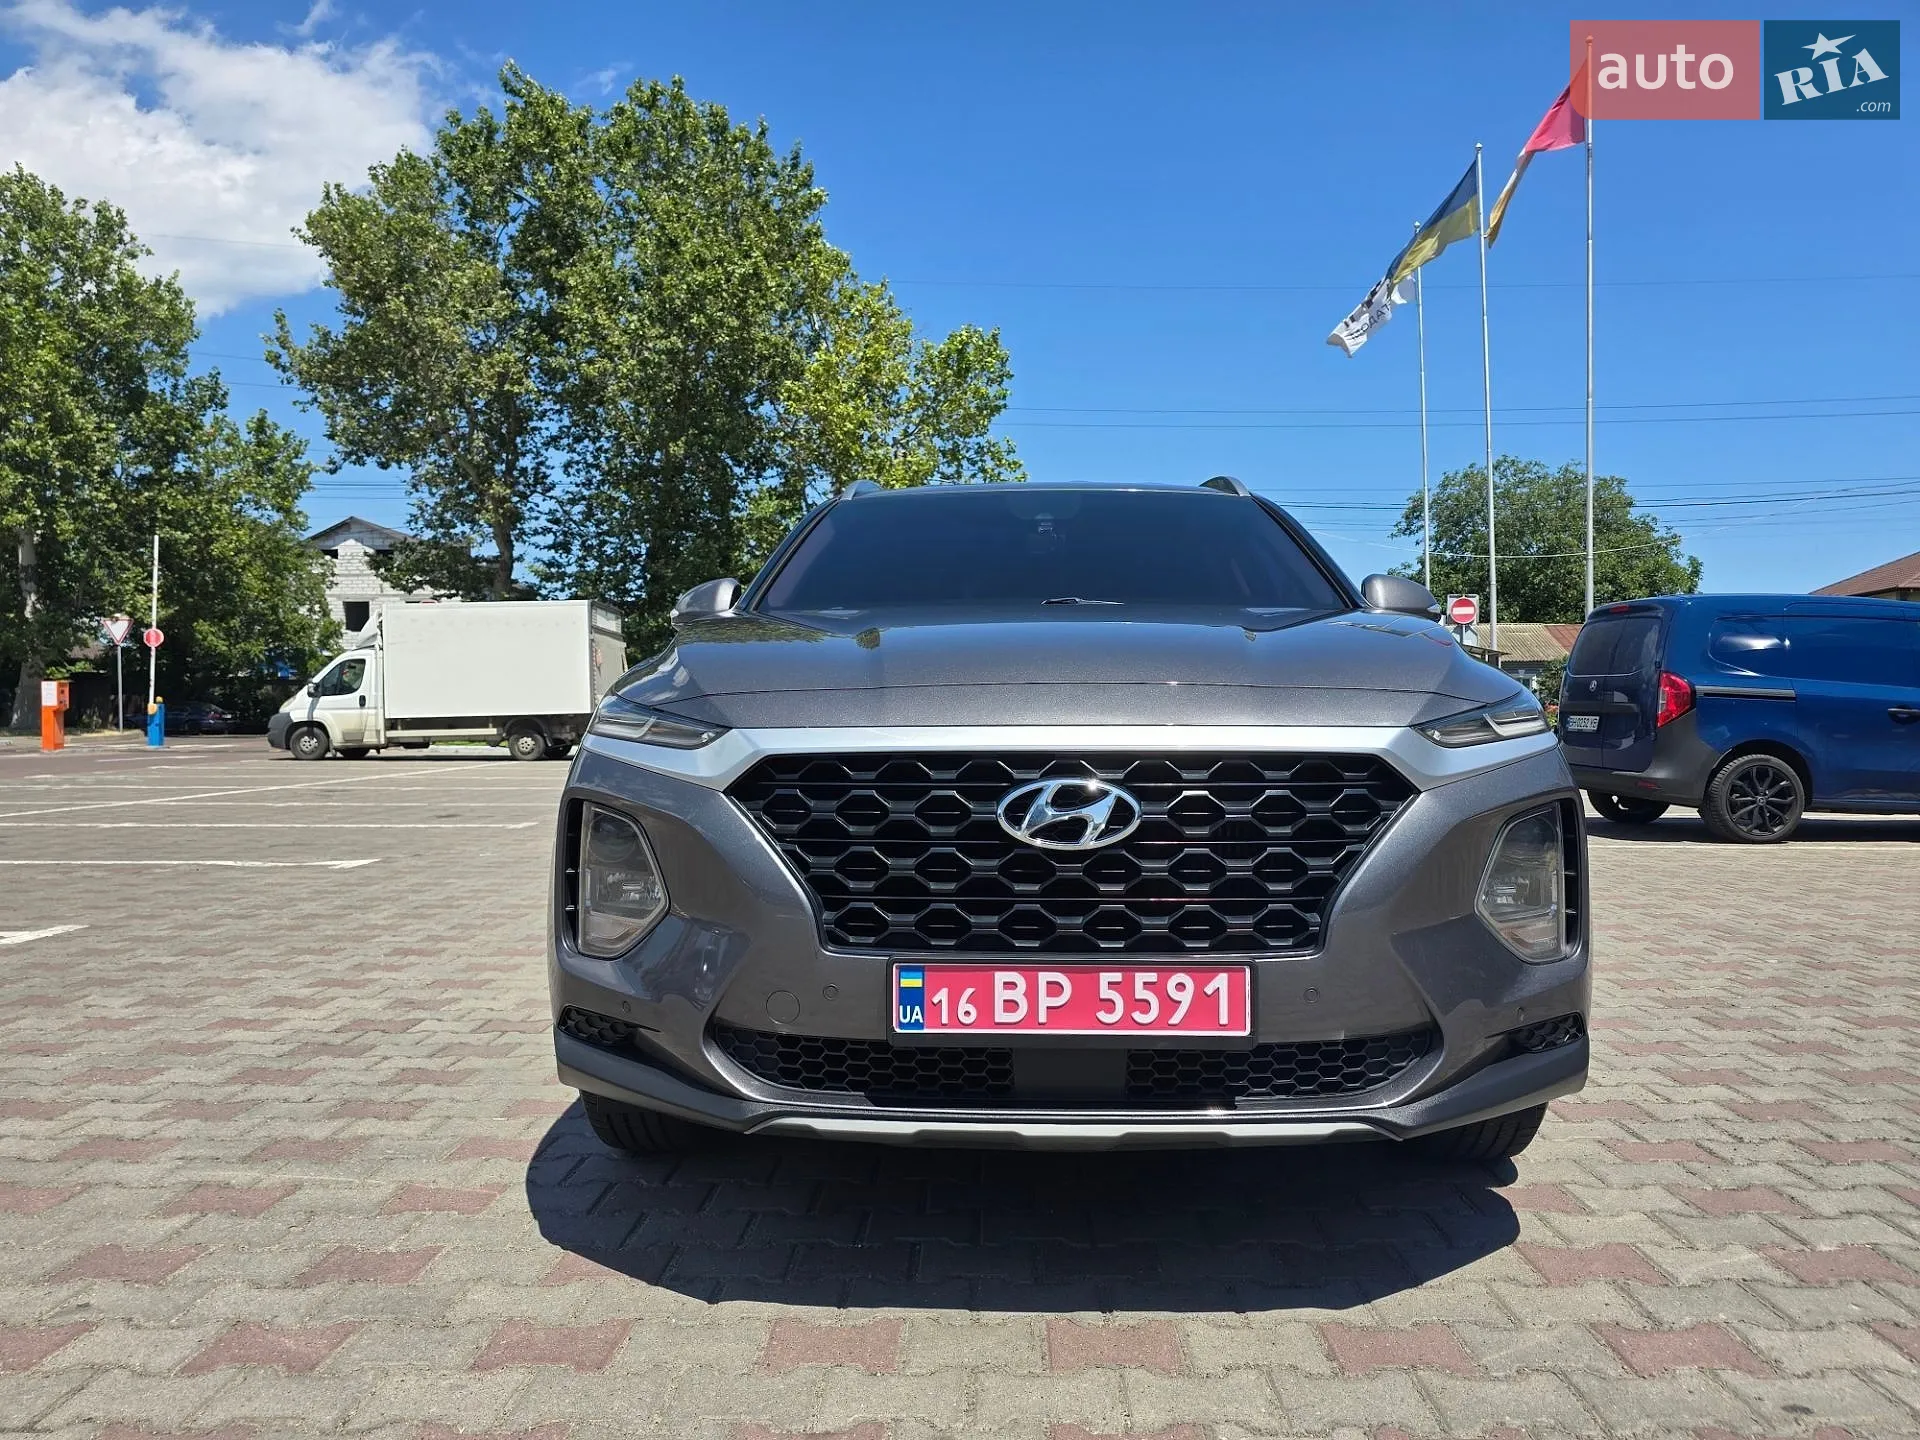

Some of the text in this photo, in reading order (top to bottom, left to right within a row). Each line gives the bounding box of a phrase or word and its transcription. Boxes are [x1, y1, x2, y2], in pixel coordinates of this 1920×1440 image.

[899, 1005, 924, 1023] UA
[931, 971, 1229, 1026] 16 BP 5591
